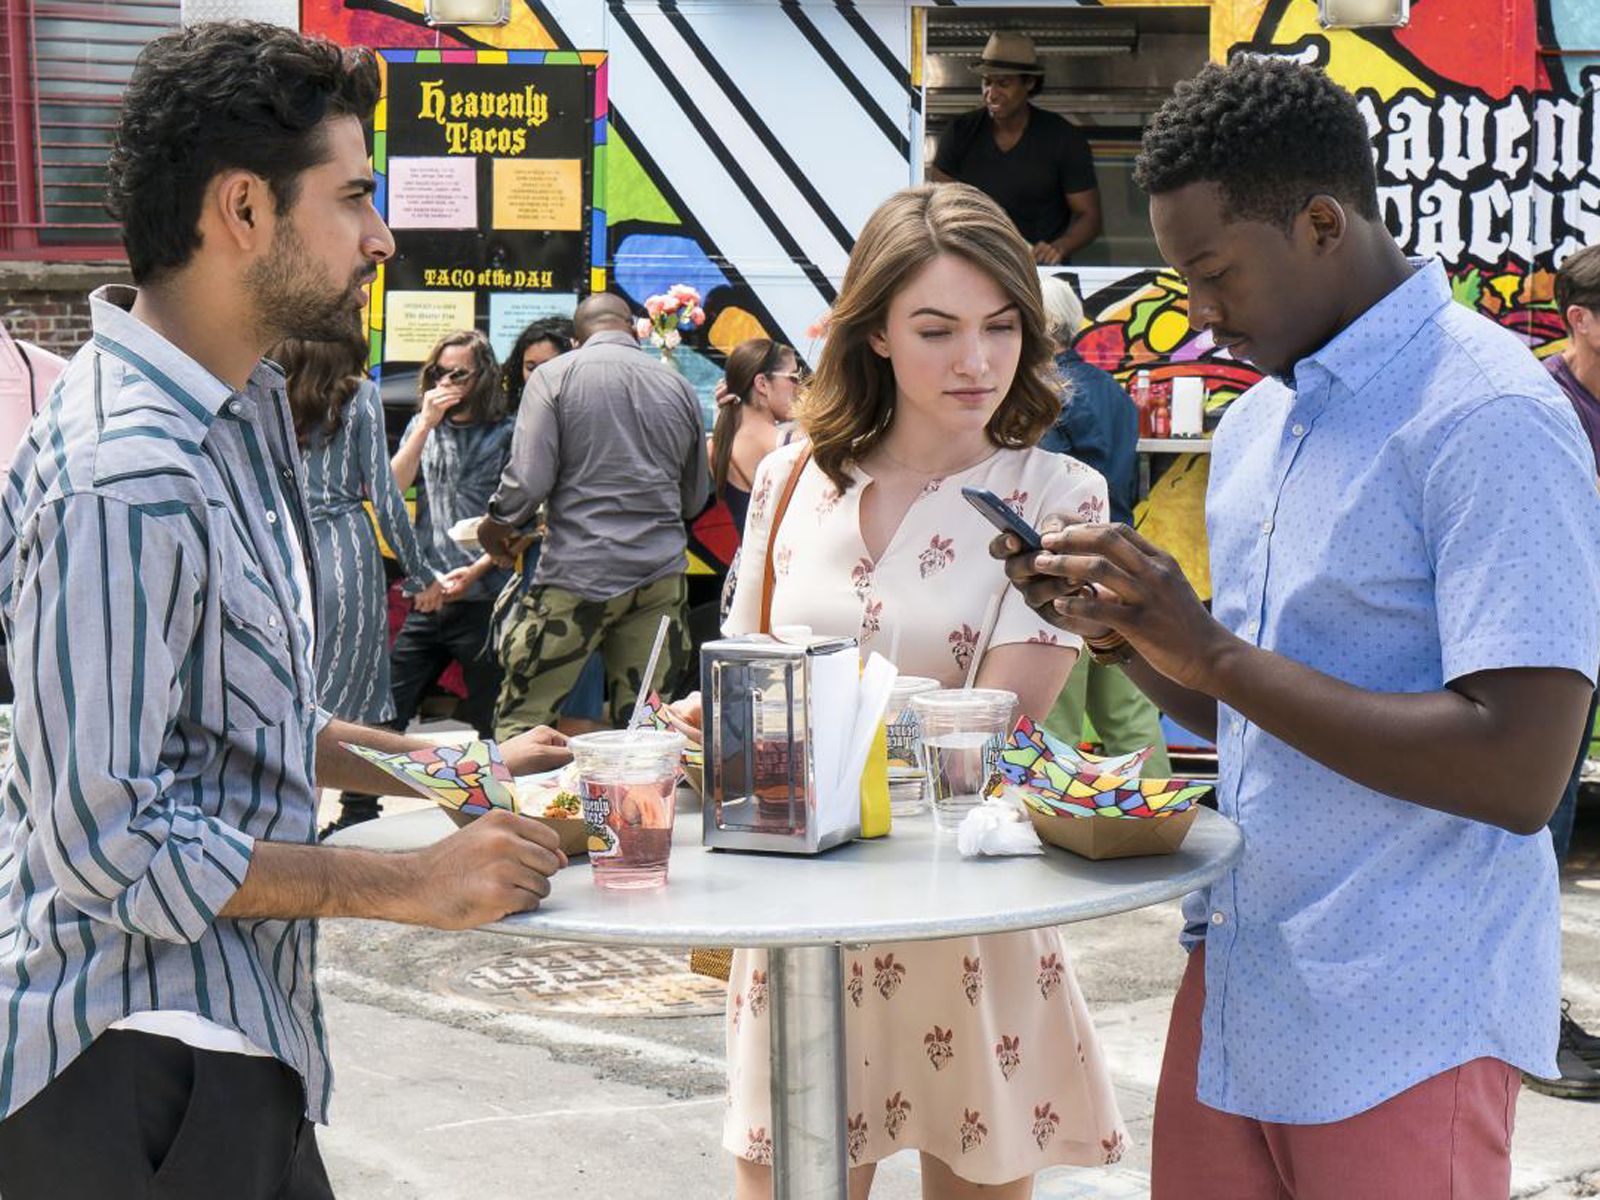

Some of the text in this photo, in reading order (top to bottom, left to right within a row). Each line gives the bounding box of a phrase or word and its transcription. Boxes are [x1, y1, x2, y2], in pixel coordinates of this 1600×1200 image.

[418, 79, 549, 126] Heavenly
[445, 122, 527, 155] Tacos
[424, 268, 475, 289] TACO
[513, 270, 553, 289] DAY
